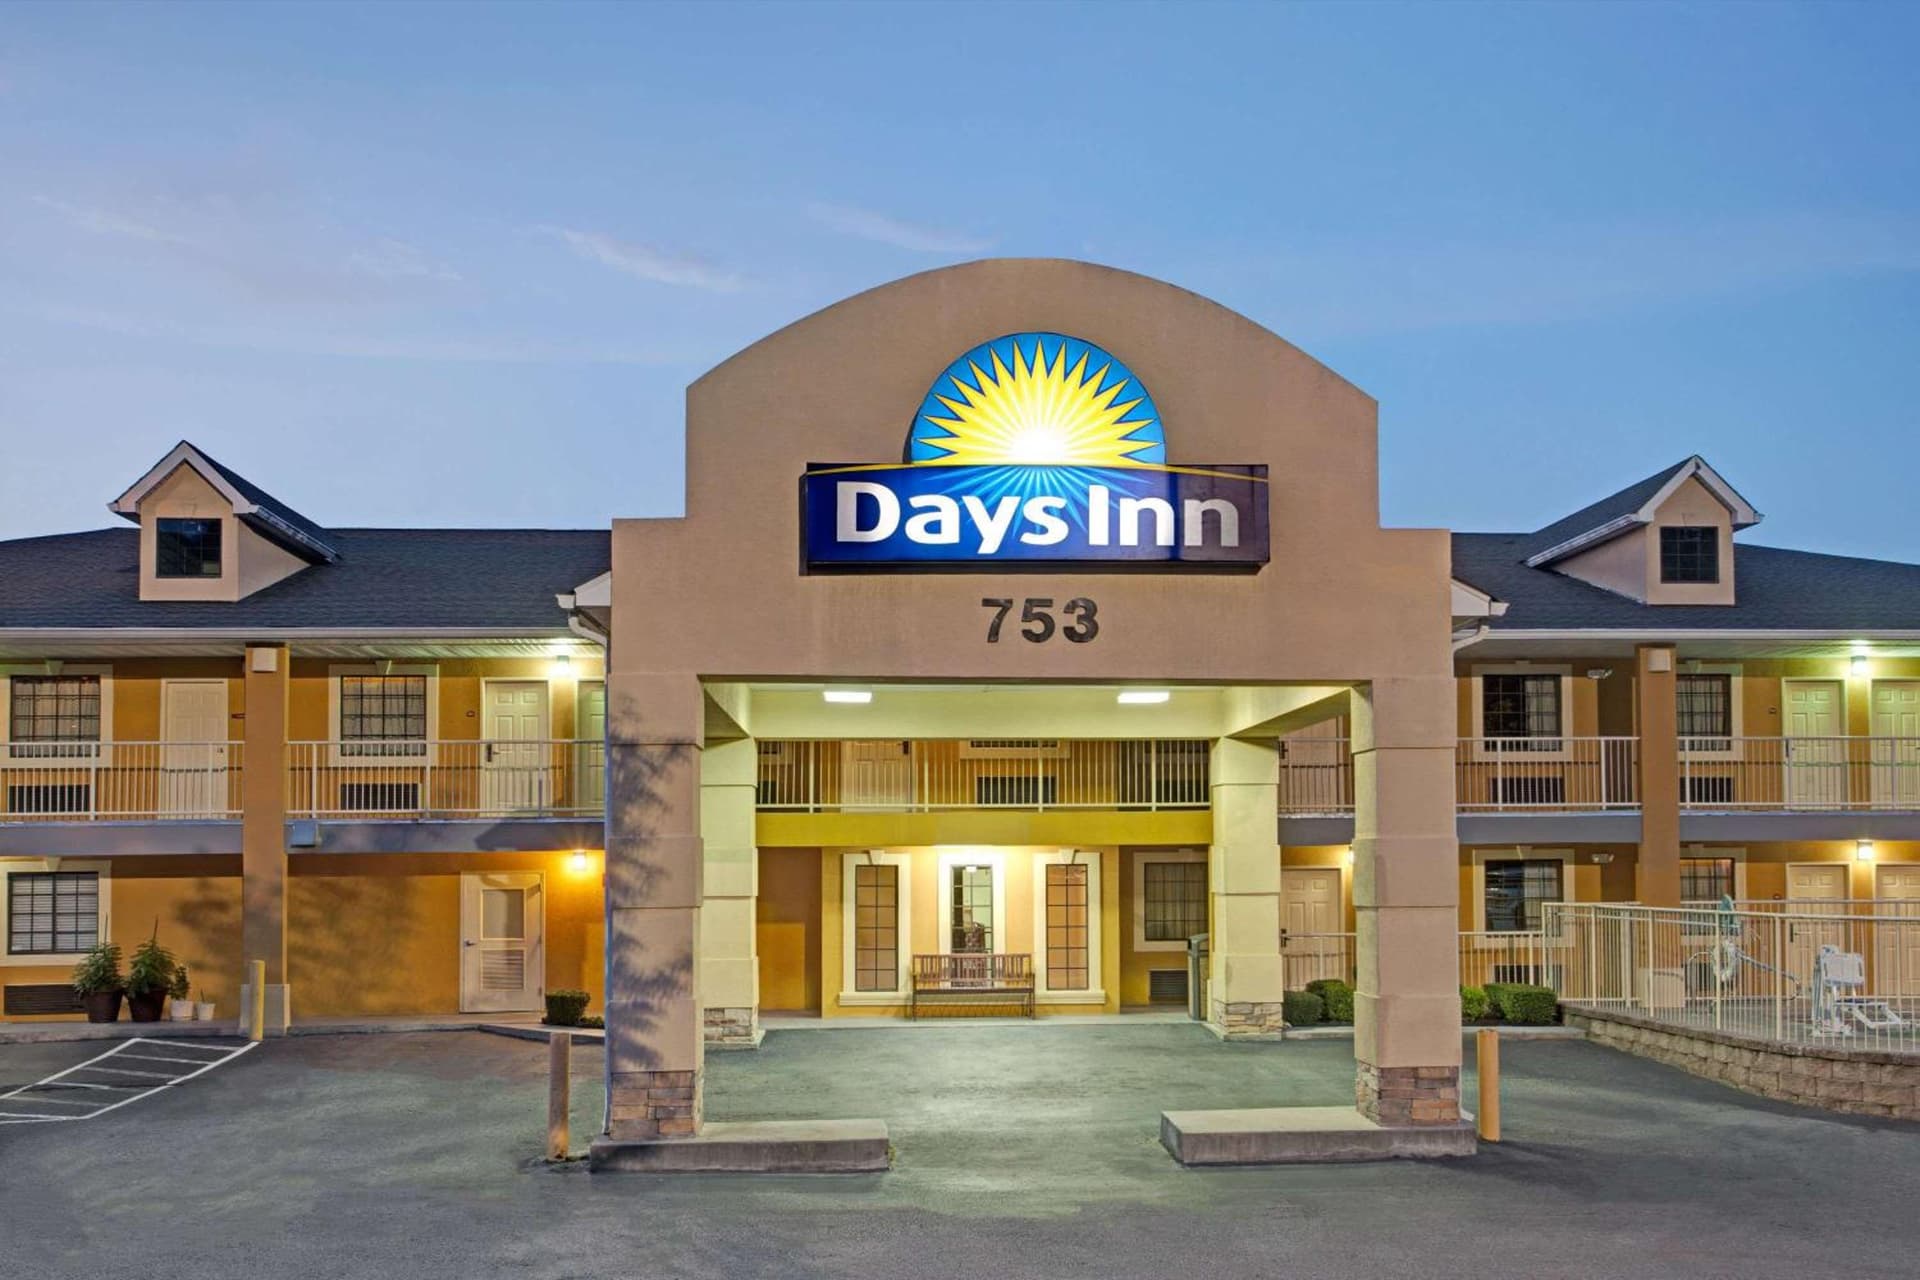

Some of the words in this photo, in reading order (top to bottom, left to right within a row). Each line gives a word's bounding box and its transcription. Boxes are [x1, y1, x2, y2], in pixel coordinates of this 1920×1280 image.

[836, 480, 1070, 554] Days
[1088, 485, 1240, 547] Inn
[981, 598, 1100, 643] 753
